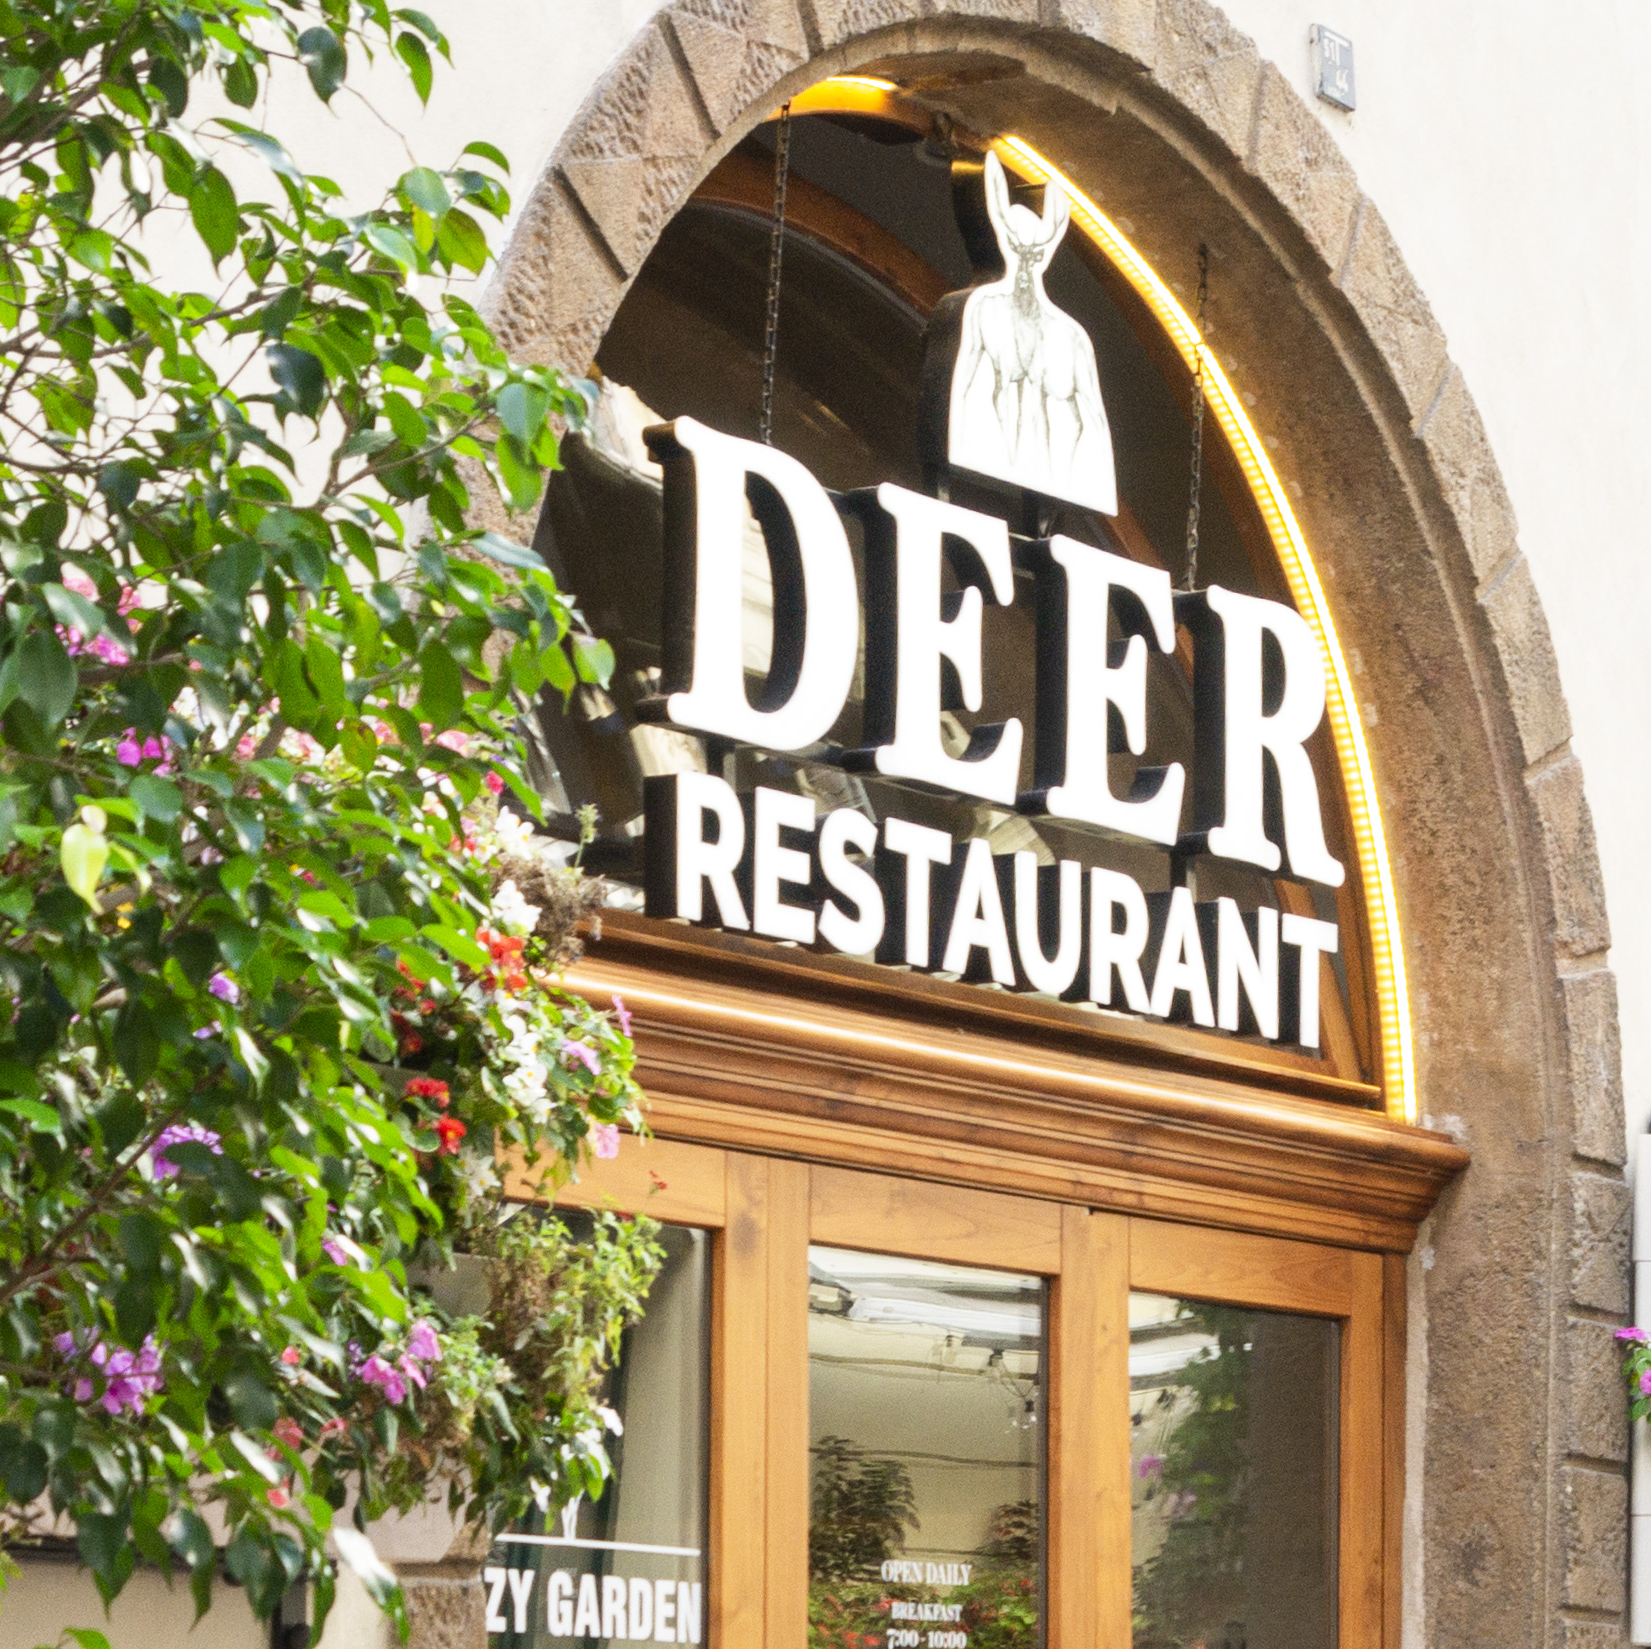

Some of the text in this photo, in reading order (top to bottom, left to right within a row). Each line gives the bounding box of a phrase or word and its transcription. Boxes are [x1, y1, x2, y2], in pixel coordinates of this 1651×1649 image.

[666, 415, 1345, 888] DEER
[676, 771, 1340, 1049] RESTAURANT
[881, 1560, 972, 1586] OPEN DAILY
[483, 1566, 702, 1645] ZY GARDEN
[891, 1601, 963, 1622] BREAKFAST
[927, 1630, 968, 1649] 10:00
